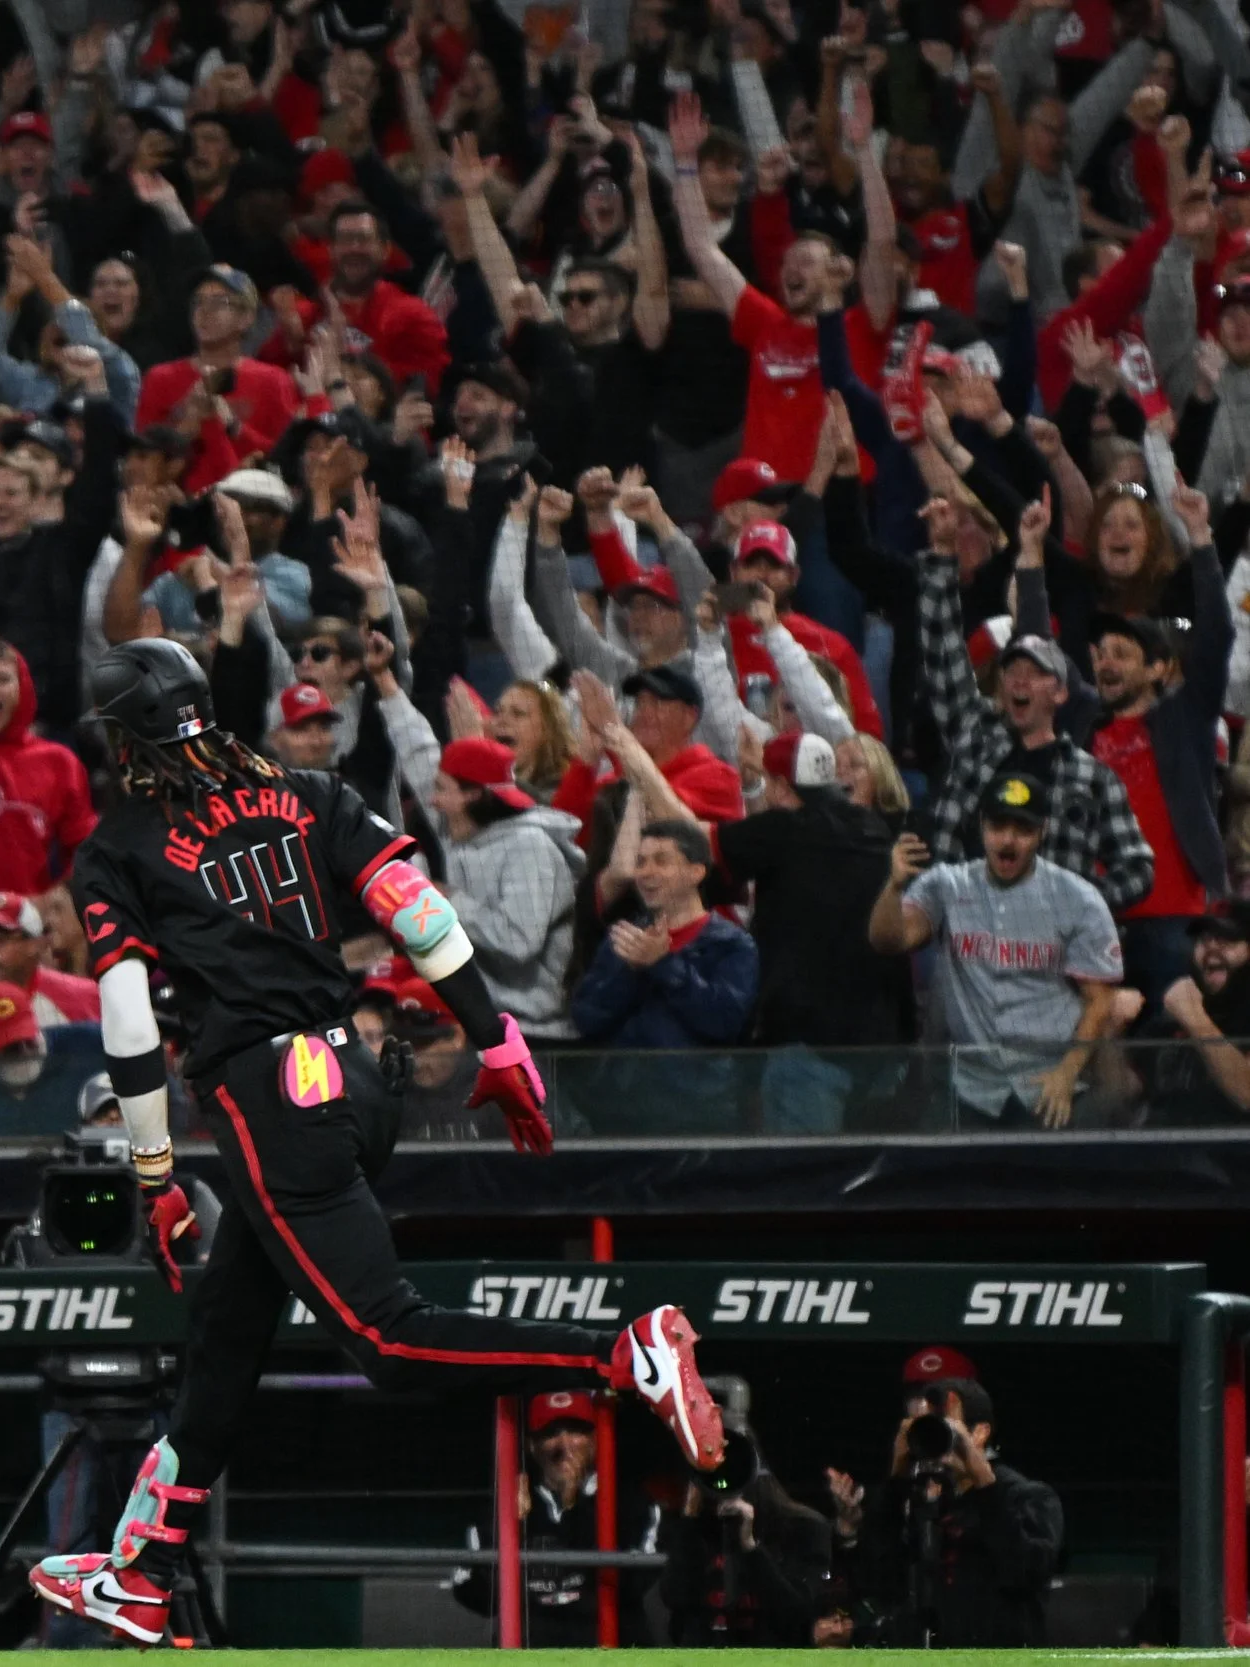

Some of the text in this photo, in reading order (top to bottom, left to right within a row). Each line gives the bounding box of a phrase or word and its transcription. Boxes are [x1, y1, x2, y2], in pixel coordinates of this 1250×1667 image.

[164, 787, 317, 873] DE LA CRUZ
[199, 832, 329, 942] 44
[466, 1277, 620, 1319] STIHL
[713, 1280, 869, 1323] STIHL
[964, 1283, 1122, 1325] STIHL
